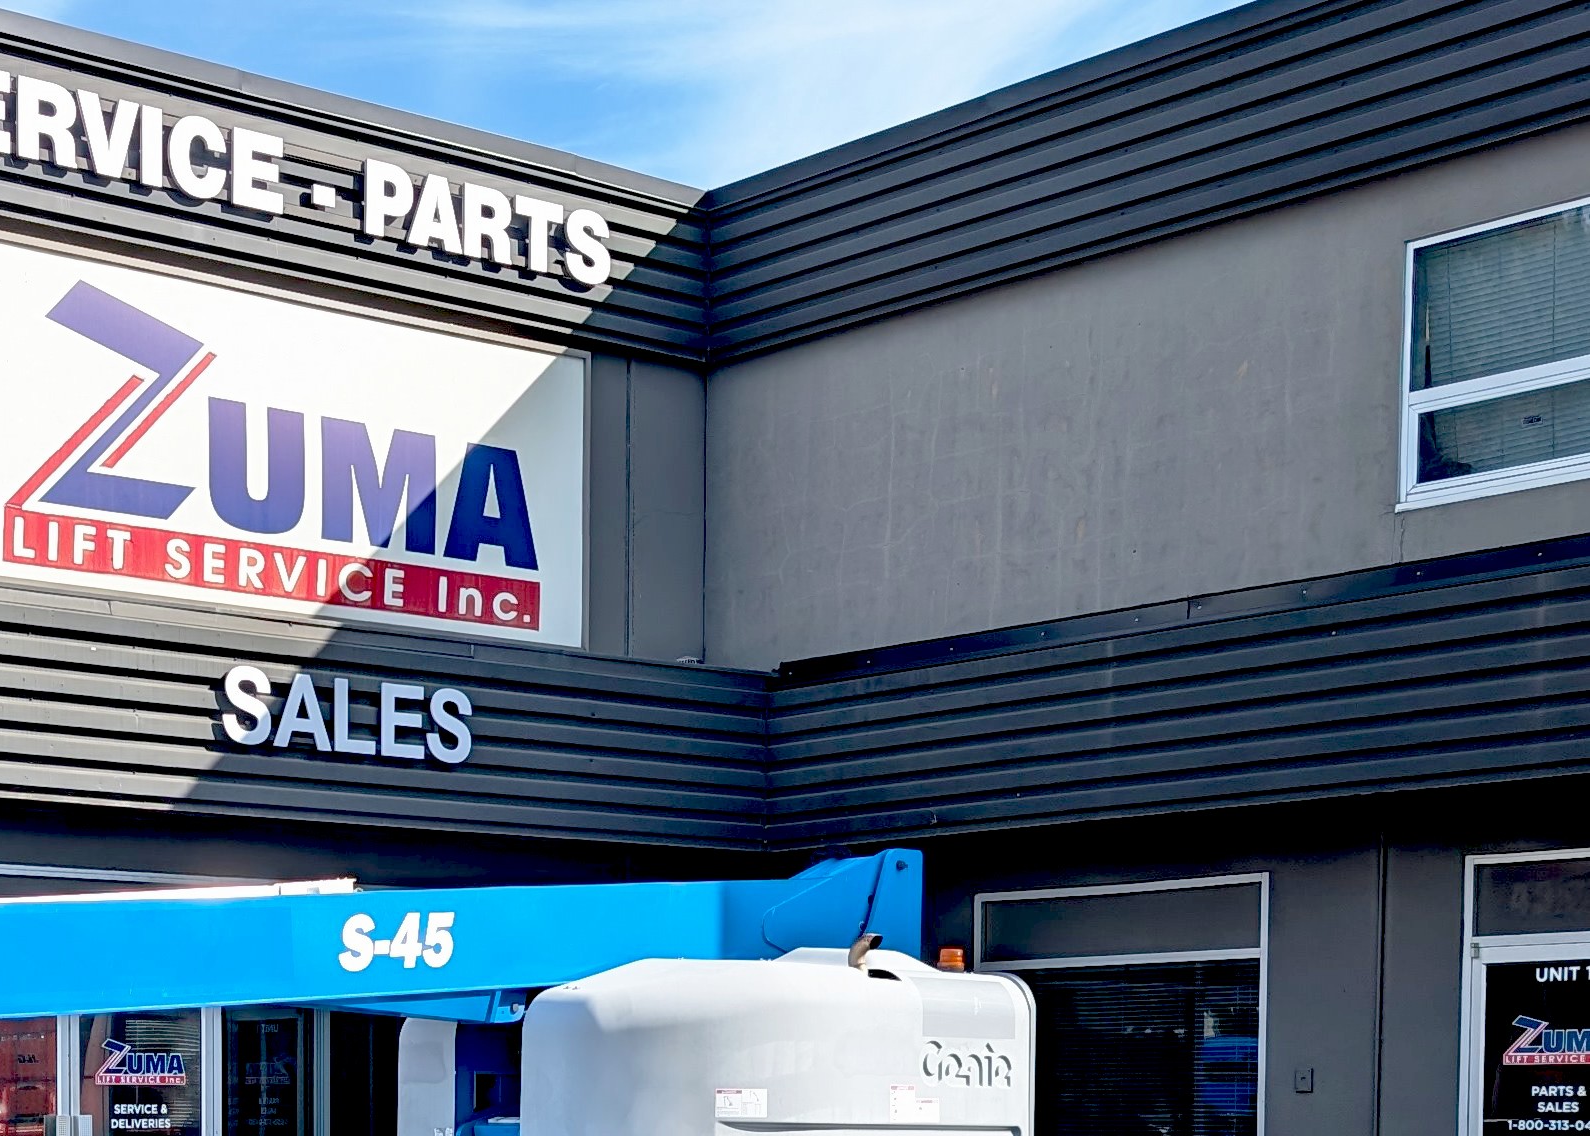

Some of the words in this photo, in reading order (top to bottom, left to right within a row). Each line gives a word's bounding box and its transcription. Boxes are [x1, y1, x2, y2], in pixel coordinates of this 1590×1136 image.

[364, 158, 612, 286] PARTS
[37, 279, 539, 572] ZUMA
[12, 515, 132, 571] LIFT
[164, 538, 406, 607] SERVICE
[437, 576, 532, 621] Inc.
[221, 665, 473, 764] SALES
[338, 911, 456, 973] S-45
[1535, 965, 1581, 983] UNIT
[101, 1038, 186, 1075] ZUMA
[920, 1039, 1013, 1088] Genie
[1505, 1055, 1529, 1063] LIFT
[1534, 1055, 1586, 1063] SERVICE
[97, 1075, 119, 1084] LIFT
[120, 1075, 160, 1084] SERVICE
[1531, 1085, 1574, 1097] PARTS
[1576, 1085, 1587, 1097] &
[113, 1103, 158, 1115] SERVICE
[160, 1103, 168, 1114] &
[1537, 1101, 1580, 1113] SALES
[110, 1118, 171, 1129] DELIVERIES
